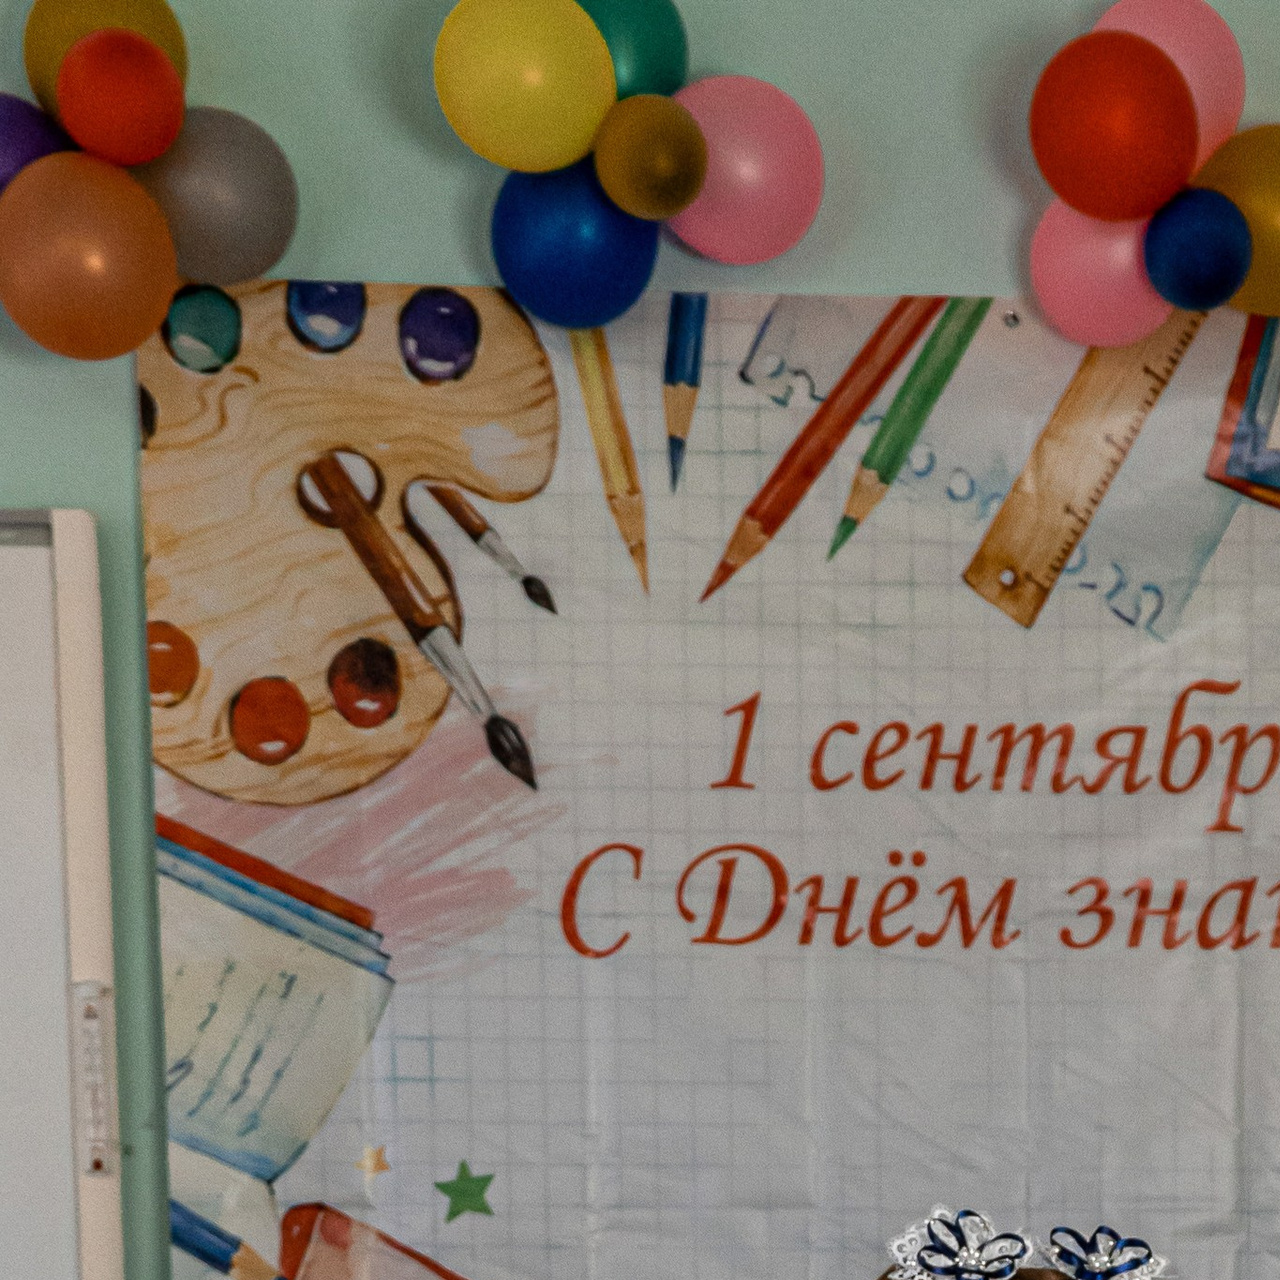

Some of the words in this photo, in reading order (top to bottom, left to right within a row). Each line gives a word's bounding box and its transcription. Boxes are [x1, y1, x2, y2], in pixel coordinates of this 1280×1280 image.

[711, 691, 761, 790] 1
[559, 842, 645, 959] С
[676, 842, 1021, 950] Днём
